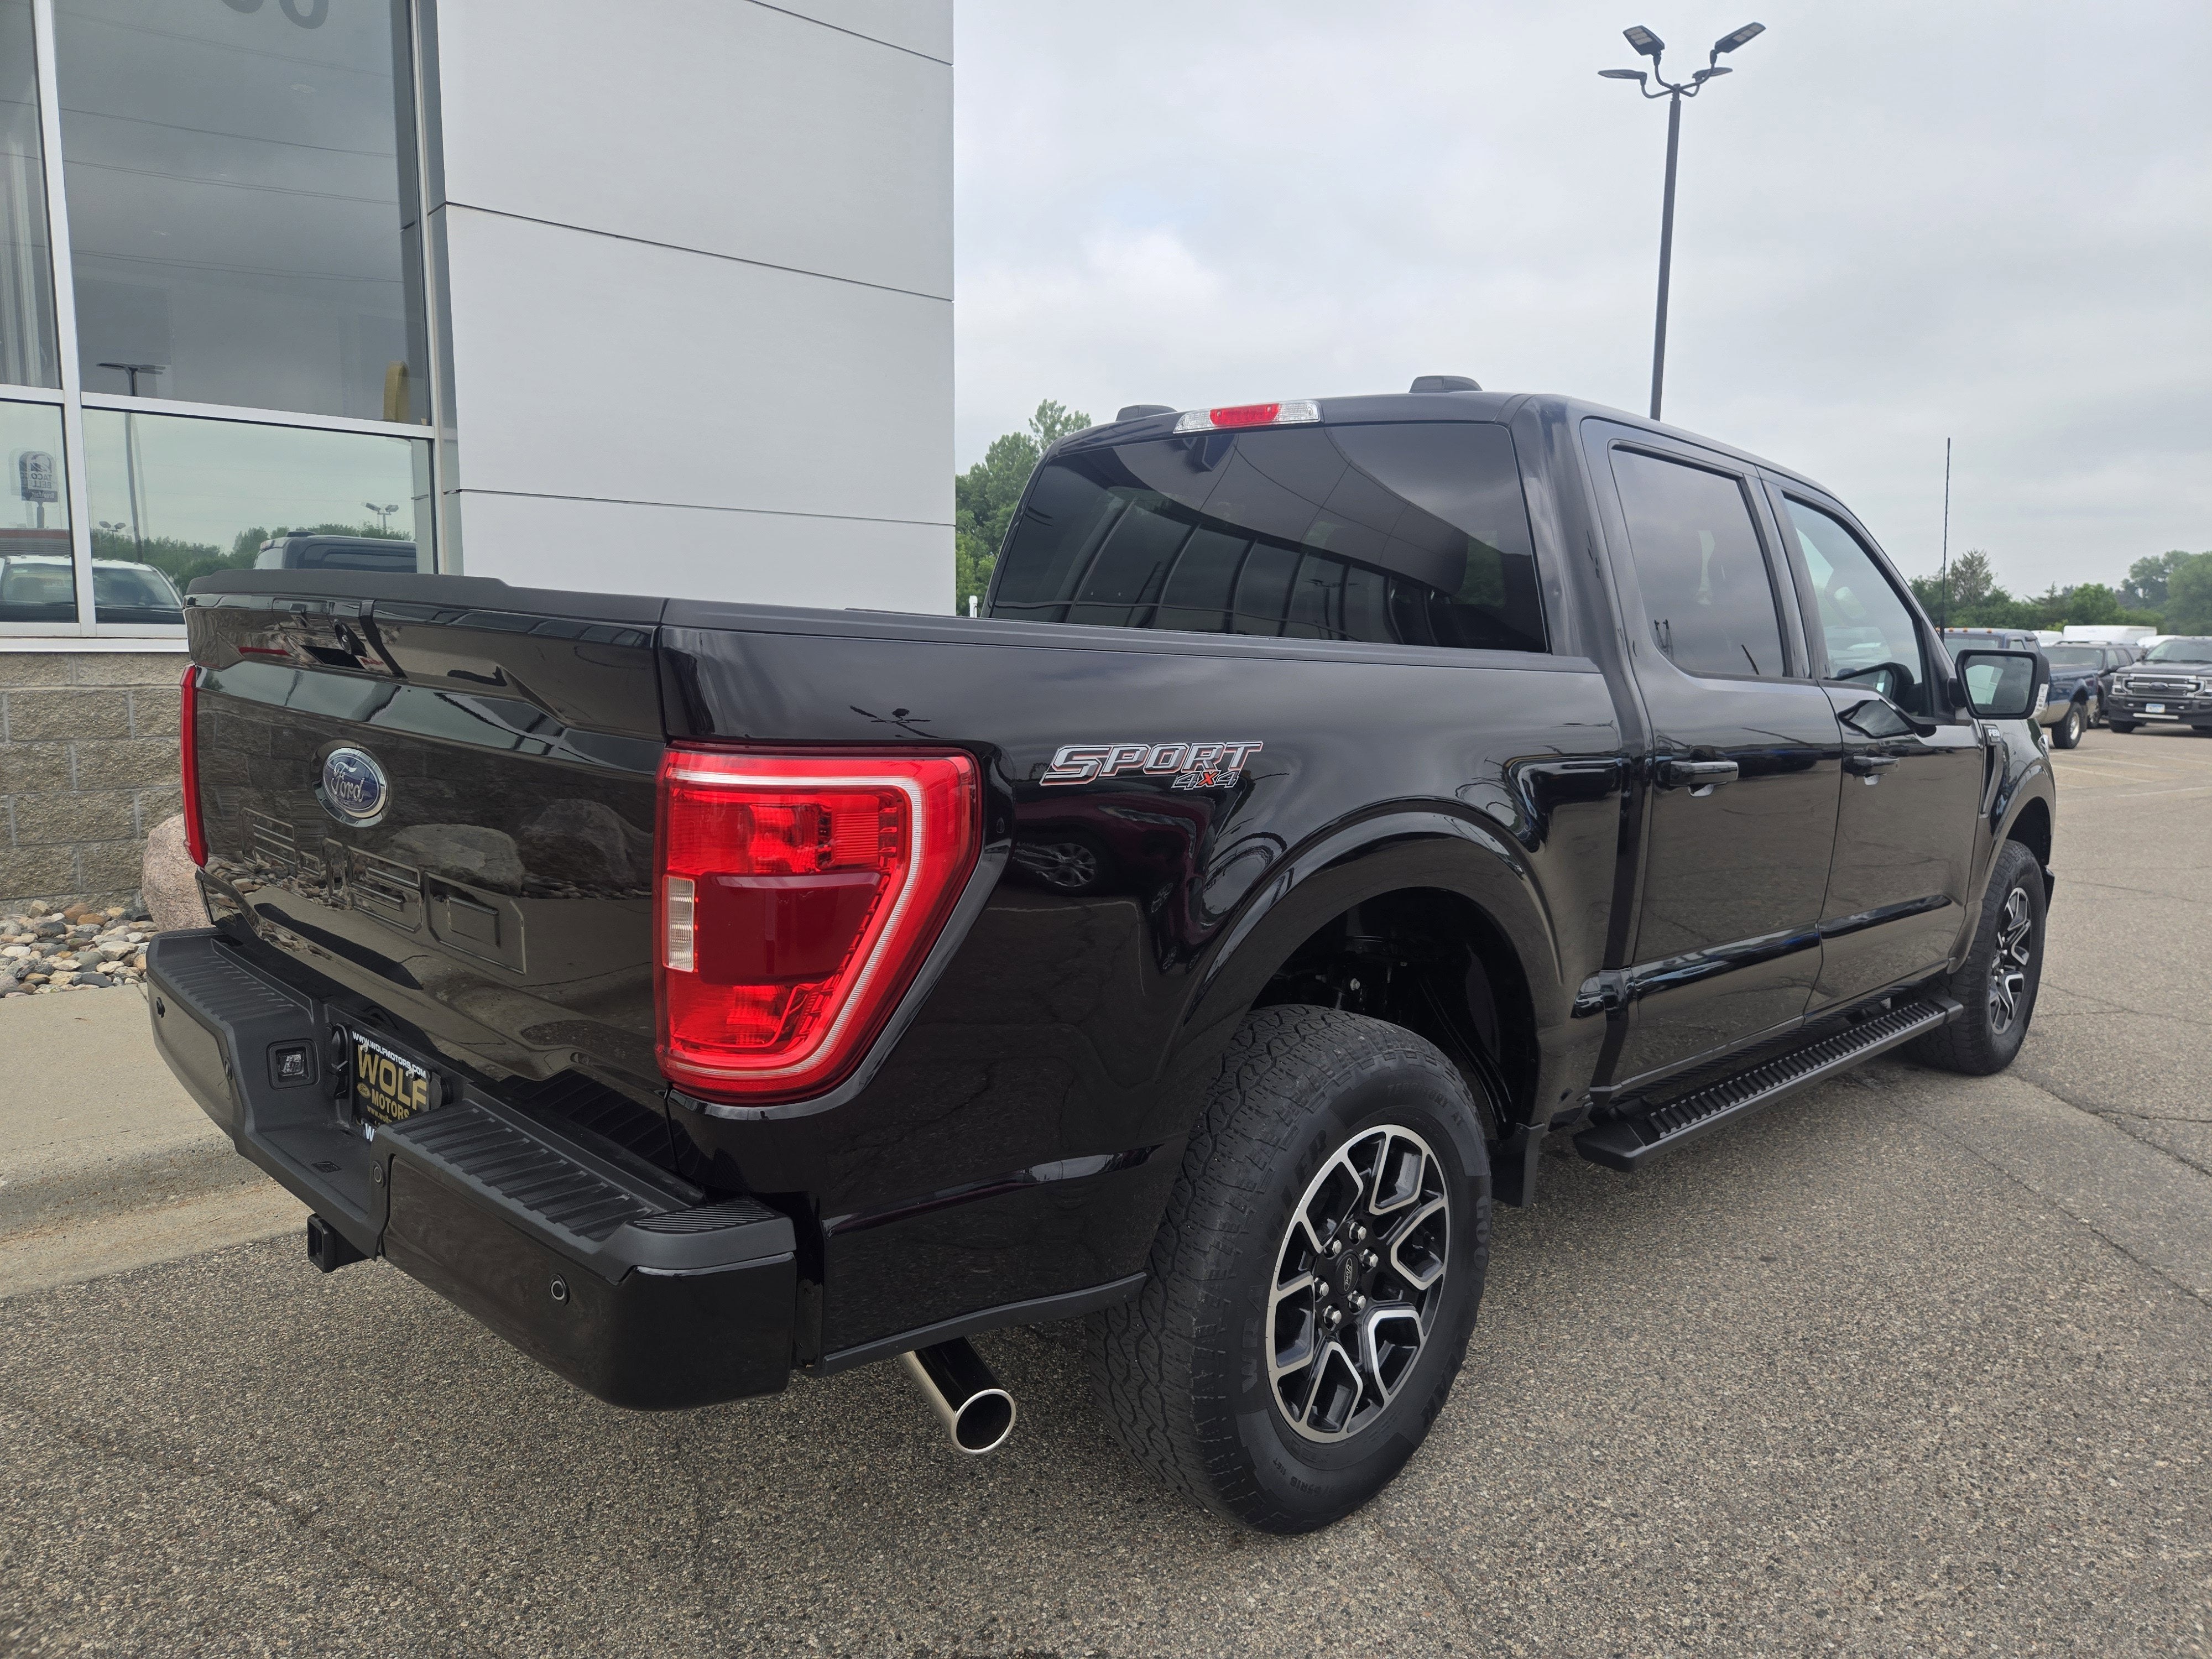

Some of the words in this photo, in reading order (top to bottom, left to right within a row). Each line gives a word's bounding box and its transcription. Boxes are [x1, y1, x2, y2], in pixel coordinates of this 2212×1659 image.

[331, 761, 365, 802] Ford
[1040, 741, 1263, 786] SPORT
[240, 806, 526, 975] F-150
[358, 1045, 427, 1110] WOLF
[372, 1088, 409, 1120] MOTORS
[1241, 1129, 1327, 1394] WRANGLER
